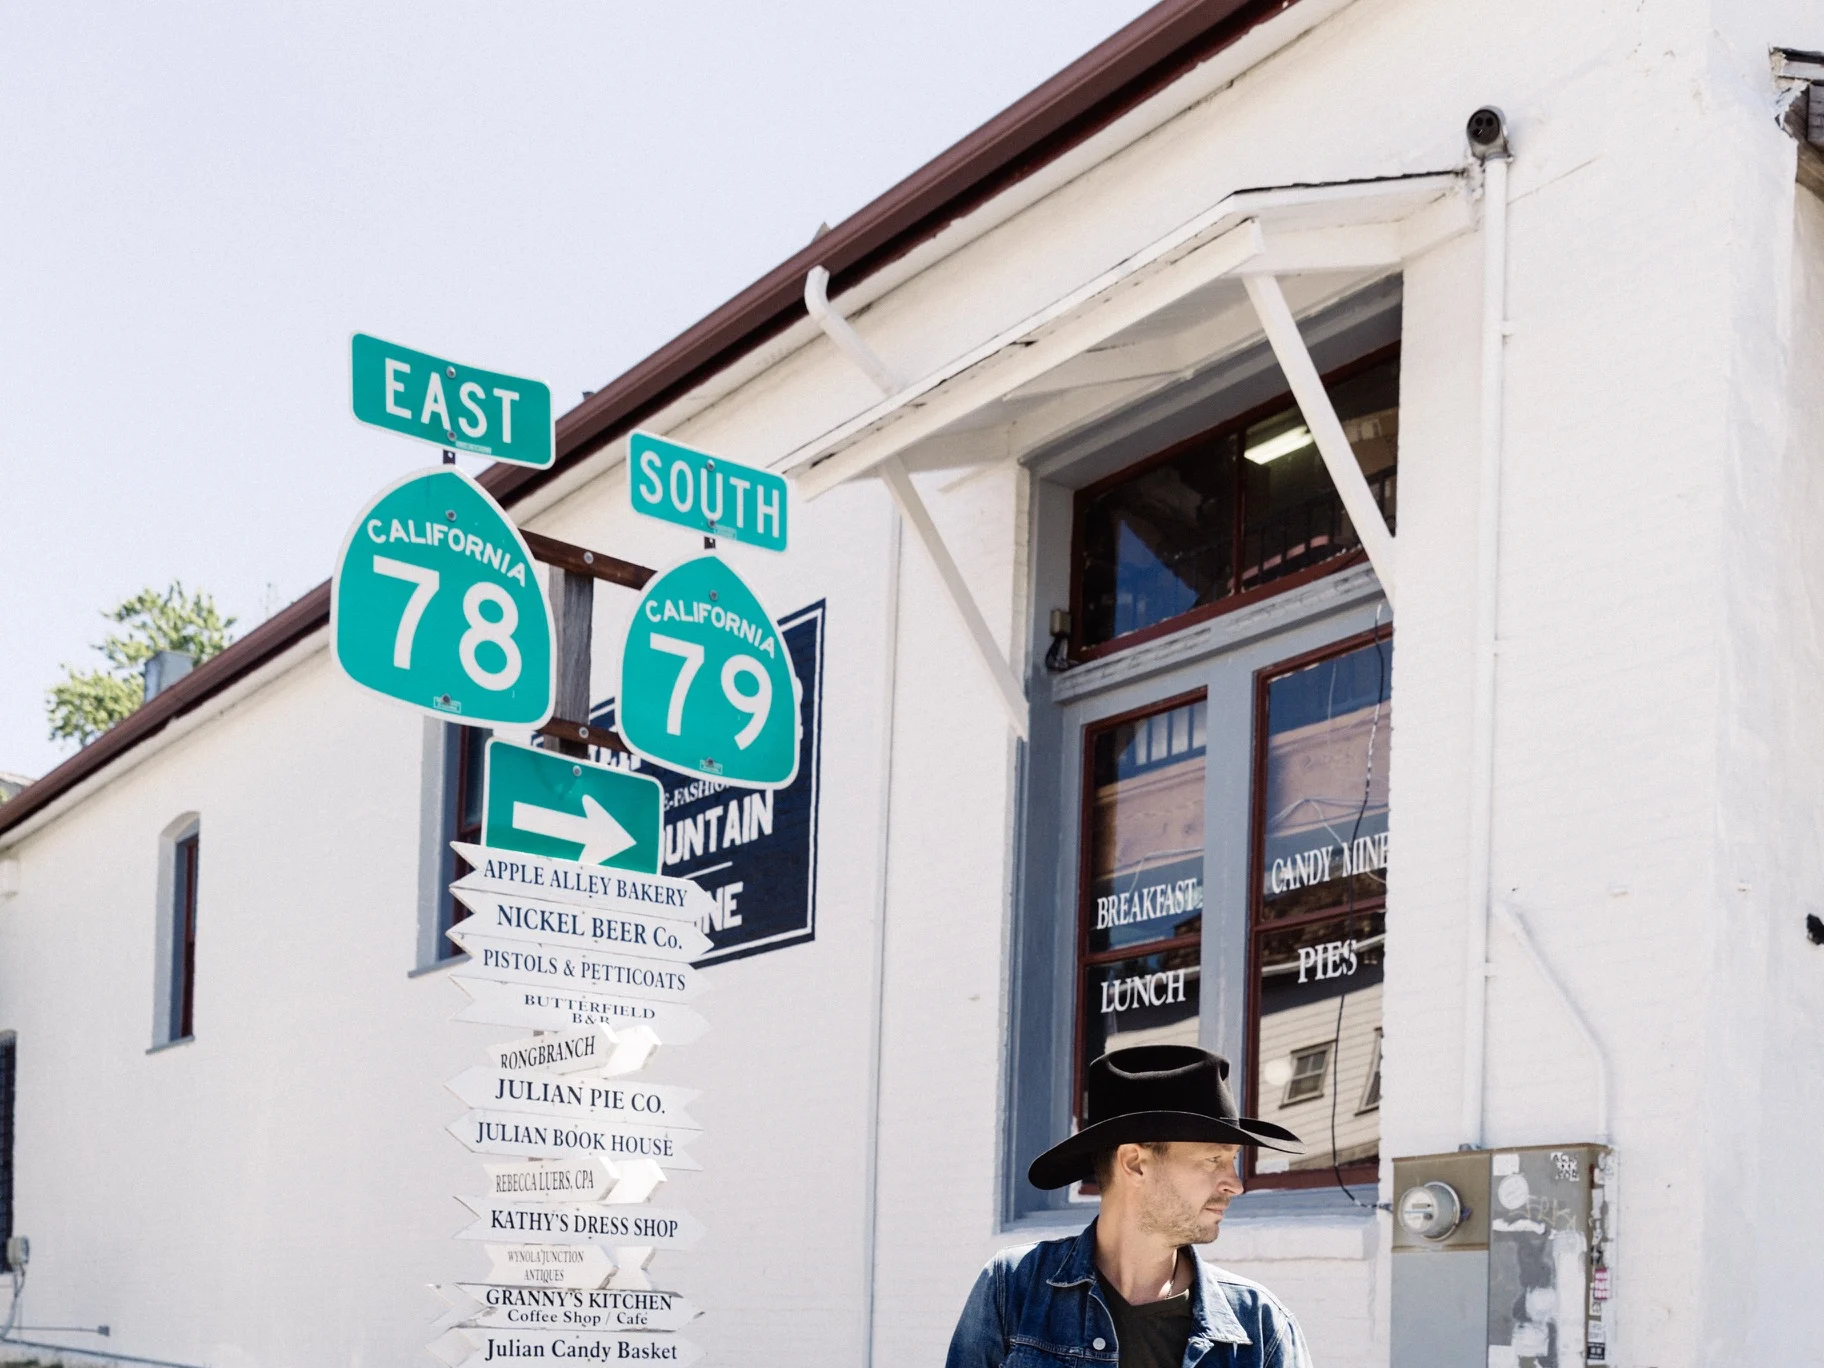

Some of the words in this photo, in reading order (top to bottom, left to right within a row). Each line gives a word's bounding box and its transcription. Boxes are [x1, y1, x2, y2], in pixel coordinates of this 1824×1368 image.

[385, 357, 519, 444] EAST
[638, 450, 781, 538] SOUTH
[367, 519, 526, 588] CALIFORNIA
[373, 554, 523, 691] 78
[645, 600, 775, 659] CALIFORNIA
[649, 632, 773, 751] 79
[662, 789, 773, 866] UNTAIN
[484, 859, 545, 886] APPLE
[550, 868, 612, 896] ALLEY
[617, 880, 688, 907] BAKERY
[1271, 846, 1334, 894] CANDY
[497, 904, 585, 936] NICKEL
[591, 917, 648, 945] BEER
[653, 926, 682, 950] Co.
[1096, 878, 1197, 931] BREAKFAST
[483, 949, 558, 976] PISTOLS
[563, 960, 575, 977] &
[581, 962, 686, 991] PETTICOATS
[1297, 938, 1358, 985] PIES
[524, 994, 656, 1019] BUTTERFIELD
[1100, 968, 1186, 1014] LUNCH
[500, 1035, 597, 1070] RONGBRANCH
[495, 1078, 583, 1106] JULIAN
[590, 1088, 625, 1110] PIE
[630, 1093, 666, 1115] CO.
[476, 1122, 548, 1146] JULIAN
[553, 1130, 606, 1151] BOOK
[611, 1134, 674, 1157] HOUSE
[496, 1172, 537, 1193] REBECCA
[575, 1169, 594, 1190] CPA
[491, 1209, 569, 1233] KATHY'S
[574, 1215, 629, 1236] DRESS
[634, 1218, 678, 1238] SHOP
[508, 1251, 542, 1264] WYNOLA
[542, 1250, 584, 1266] JUNCTION
[524, 1270, 564, 1283] ANTIQUES
[486, 1289, 584, 1309] GRANNY'S
[589, 1292, 673, 1311] KITCHEN
[507, 1310, 558, 1323] Coffee
[563, 1311, 601, 1327] Shop
[485, 1339, 545, 1361] Julian
[551, 1340, 611, 1362] Candy
[617, 1341, 677, 1360] Basket
